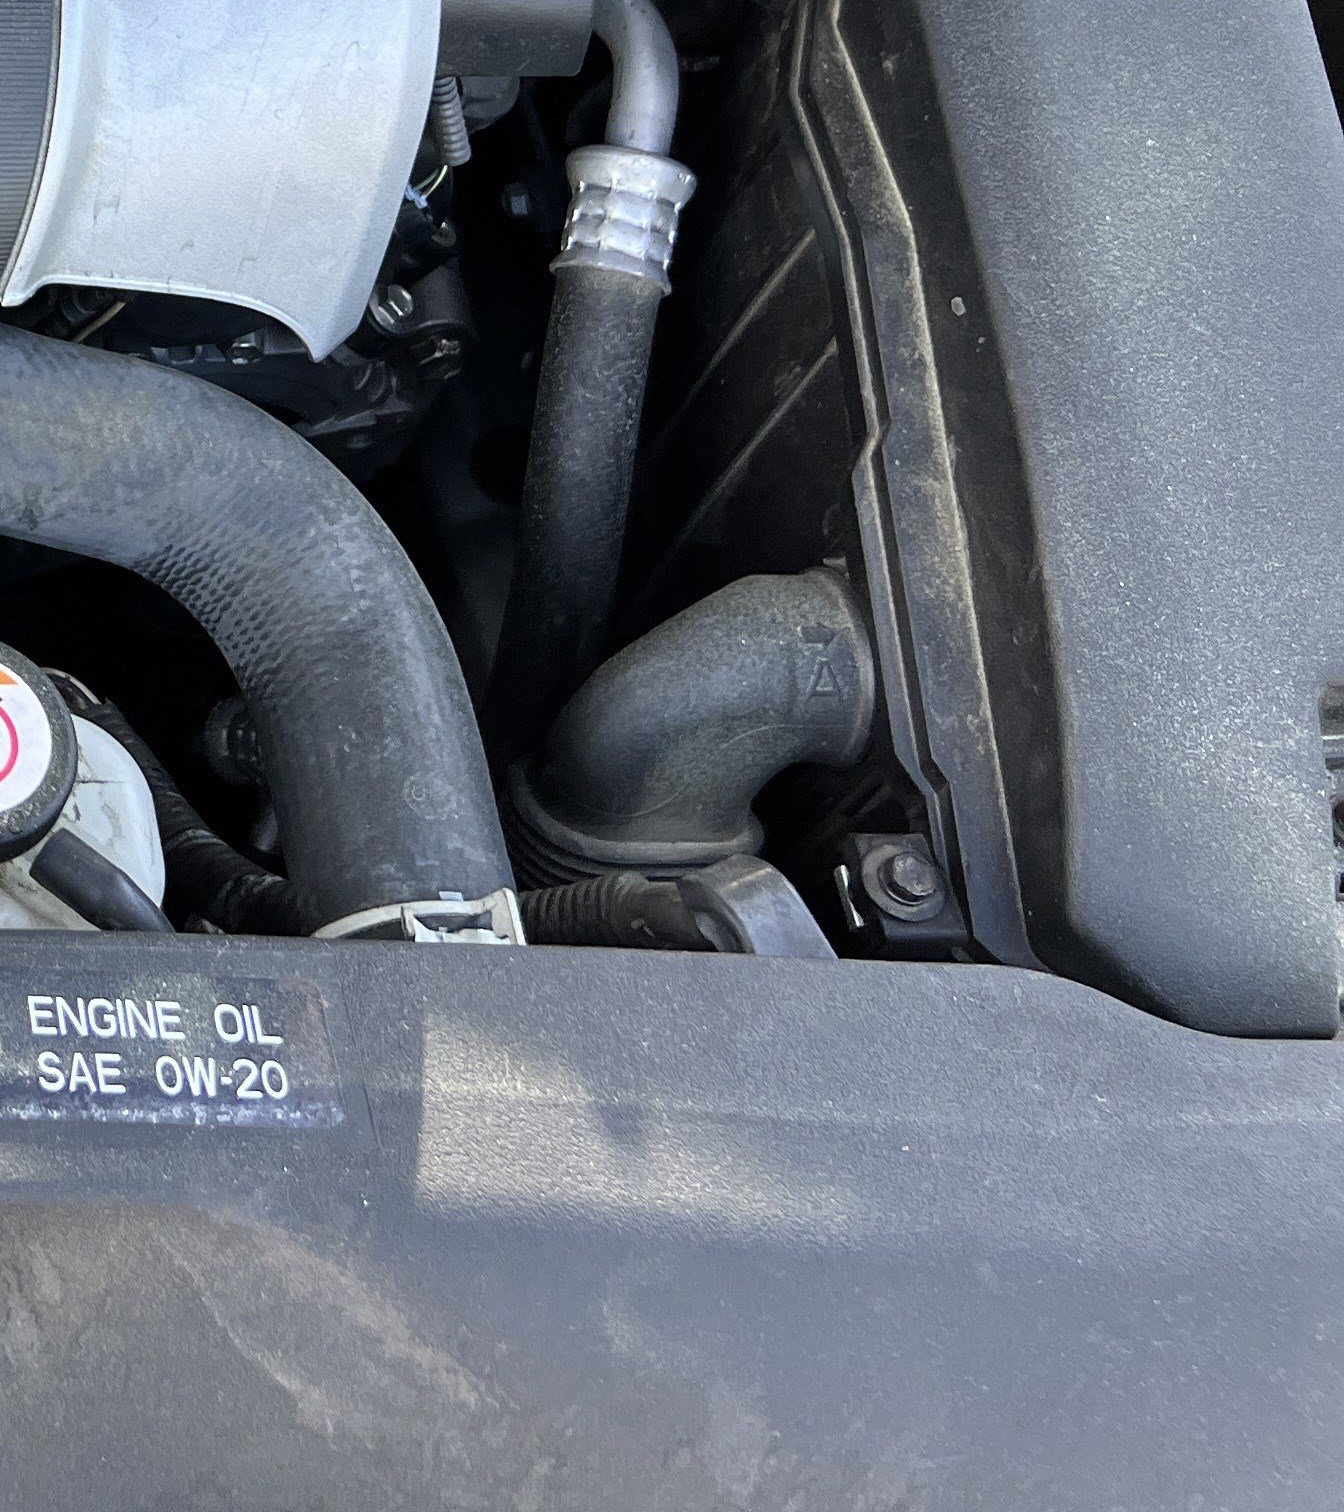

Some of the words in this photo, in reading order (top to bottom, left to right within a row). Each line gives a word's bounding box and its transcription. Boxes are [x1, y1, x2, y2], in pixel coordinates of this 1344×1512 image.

[27, 995, 186, 1040] ENGINE
[214, 1003, 284, 1045] OIL
[37, 1051, 126, 1094] SAE
